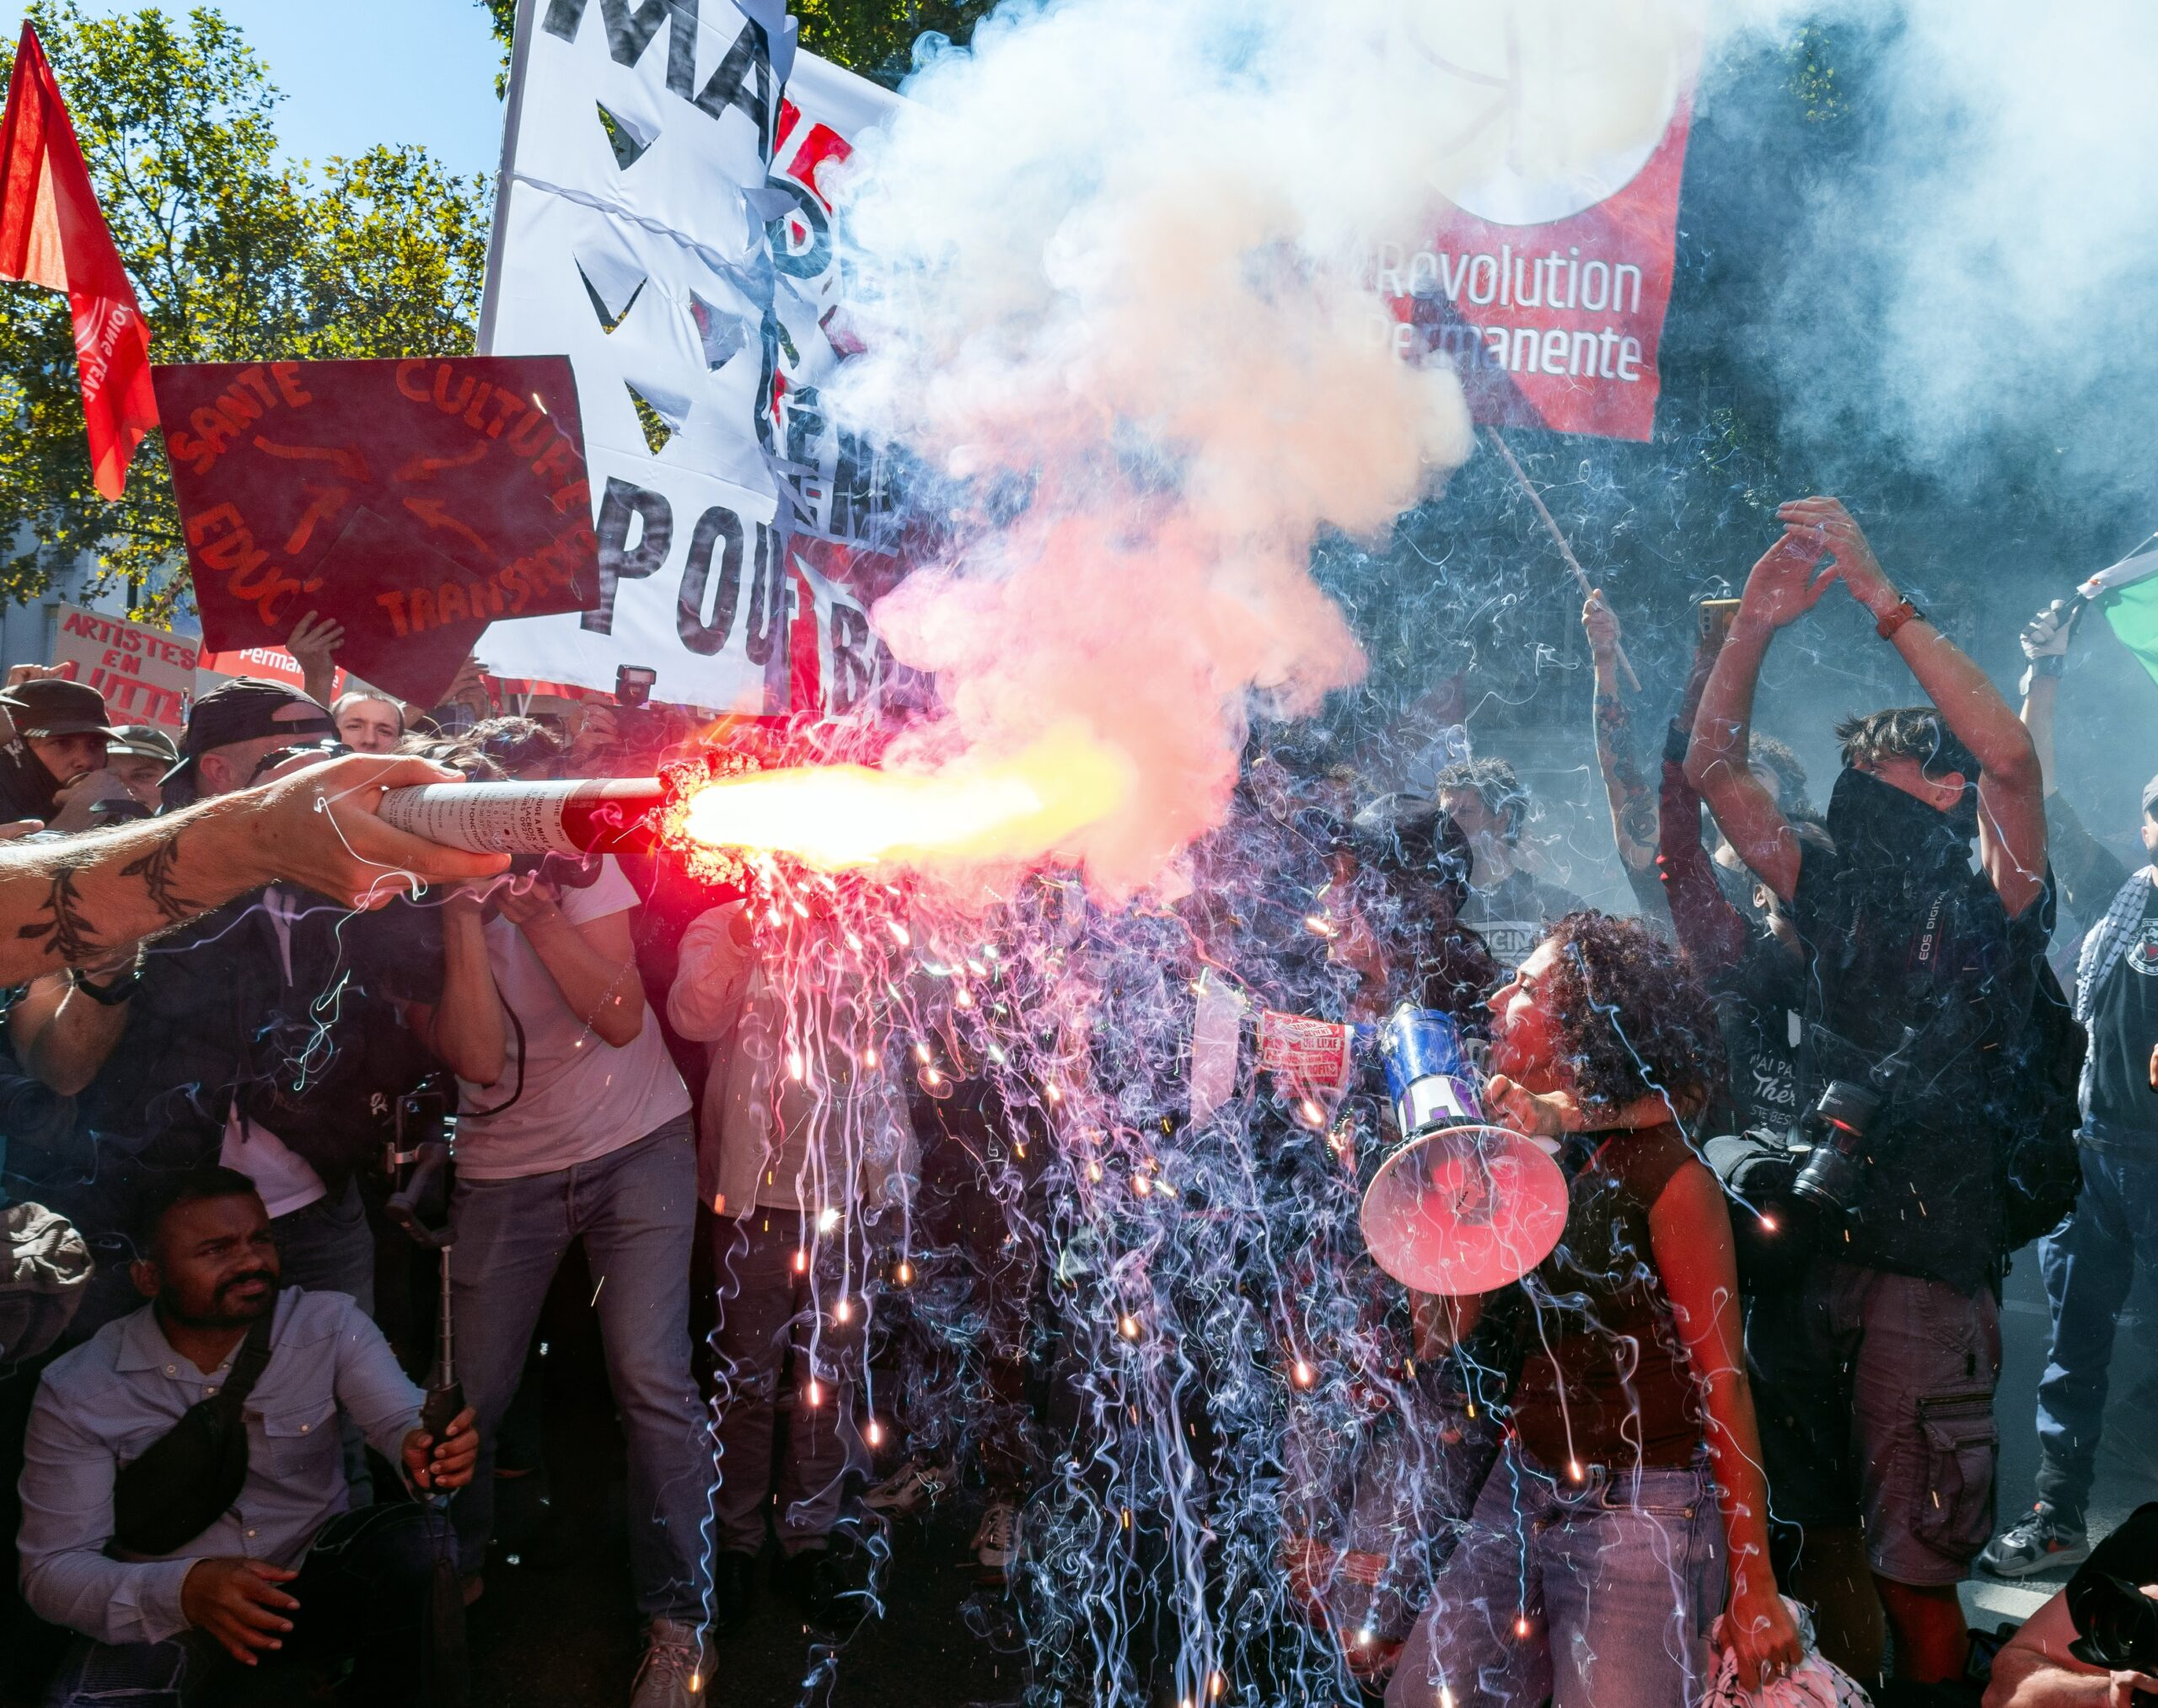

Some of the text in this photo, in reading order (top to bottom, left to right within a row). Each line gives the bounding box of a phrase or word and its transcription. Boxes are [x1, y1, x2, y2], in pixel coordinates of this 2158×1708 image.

[1377, 239, 1642, 314] Révolution
[169, 360, 313, 476] SANTE
[395, 357, 590, 514] CULTURE
[101, 648, 142, 675] EN
[519, 816, 532, 841] 09270
[1919, 933, 1932, 960] EOS
[1317, 1038, 1338, 1049] LUXE
[1777, 1061, 1796, 1079] PA
